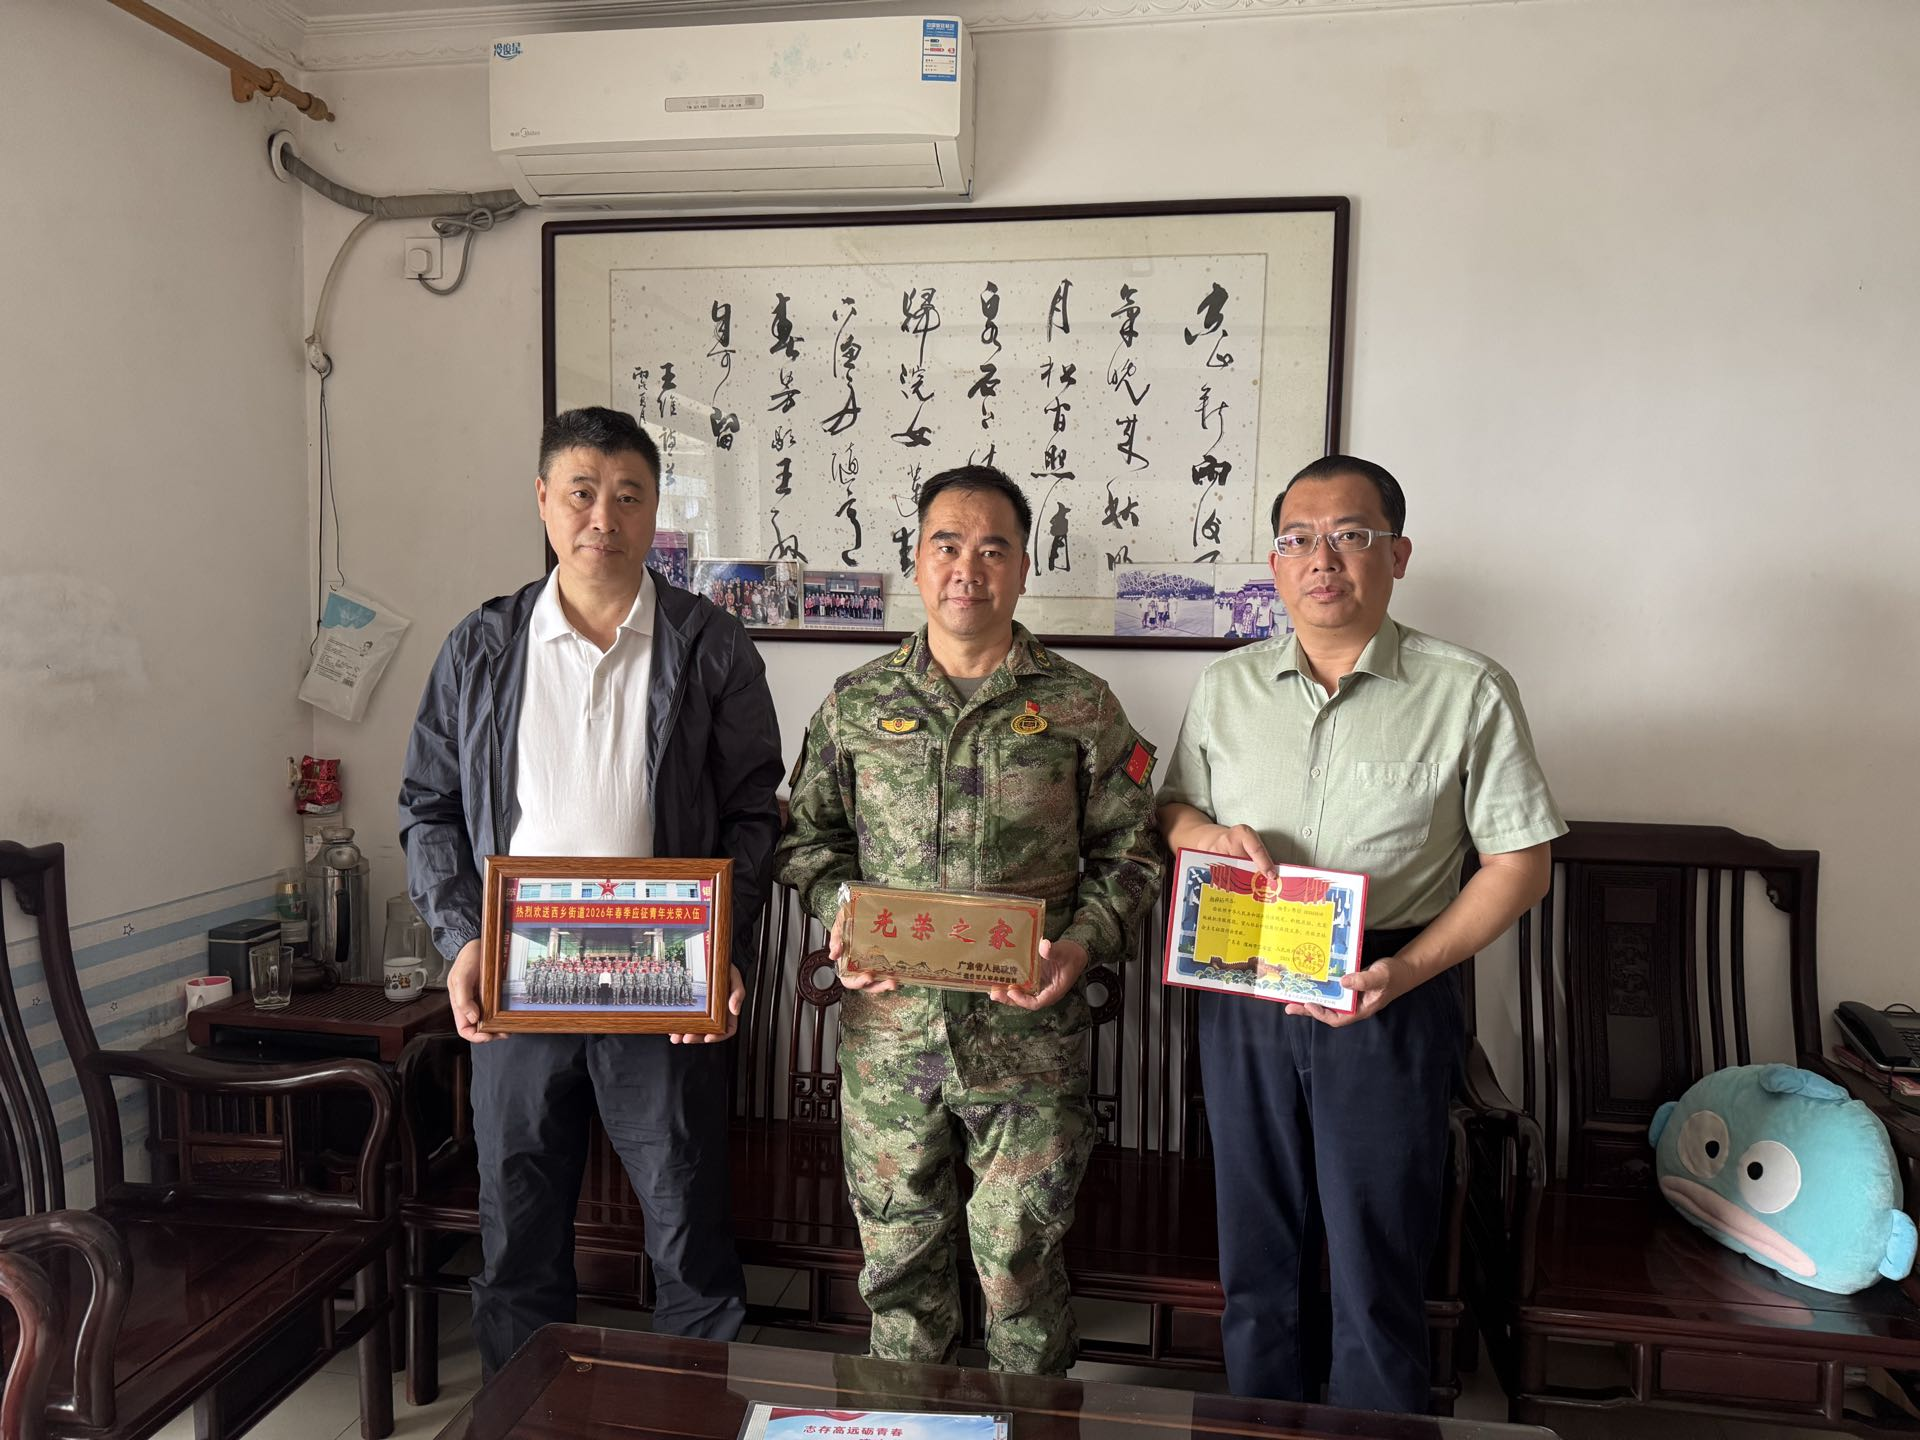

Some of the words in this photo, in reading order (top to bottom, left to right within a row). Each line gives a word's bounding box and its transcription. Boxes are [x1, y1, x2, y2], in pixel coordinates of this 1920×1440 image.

[515, 905, 701, 920] 热烈欢送西乡街道2026年春季应征青年光荣入伍
[870, 908, 1016, 950] 光荣之家
[957, 960, 1018, 976] 广东省人民政府
[803, 1425, 903, 1437] 志存高远砺青春
